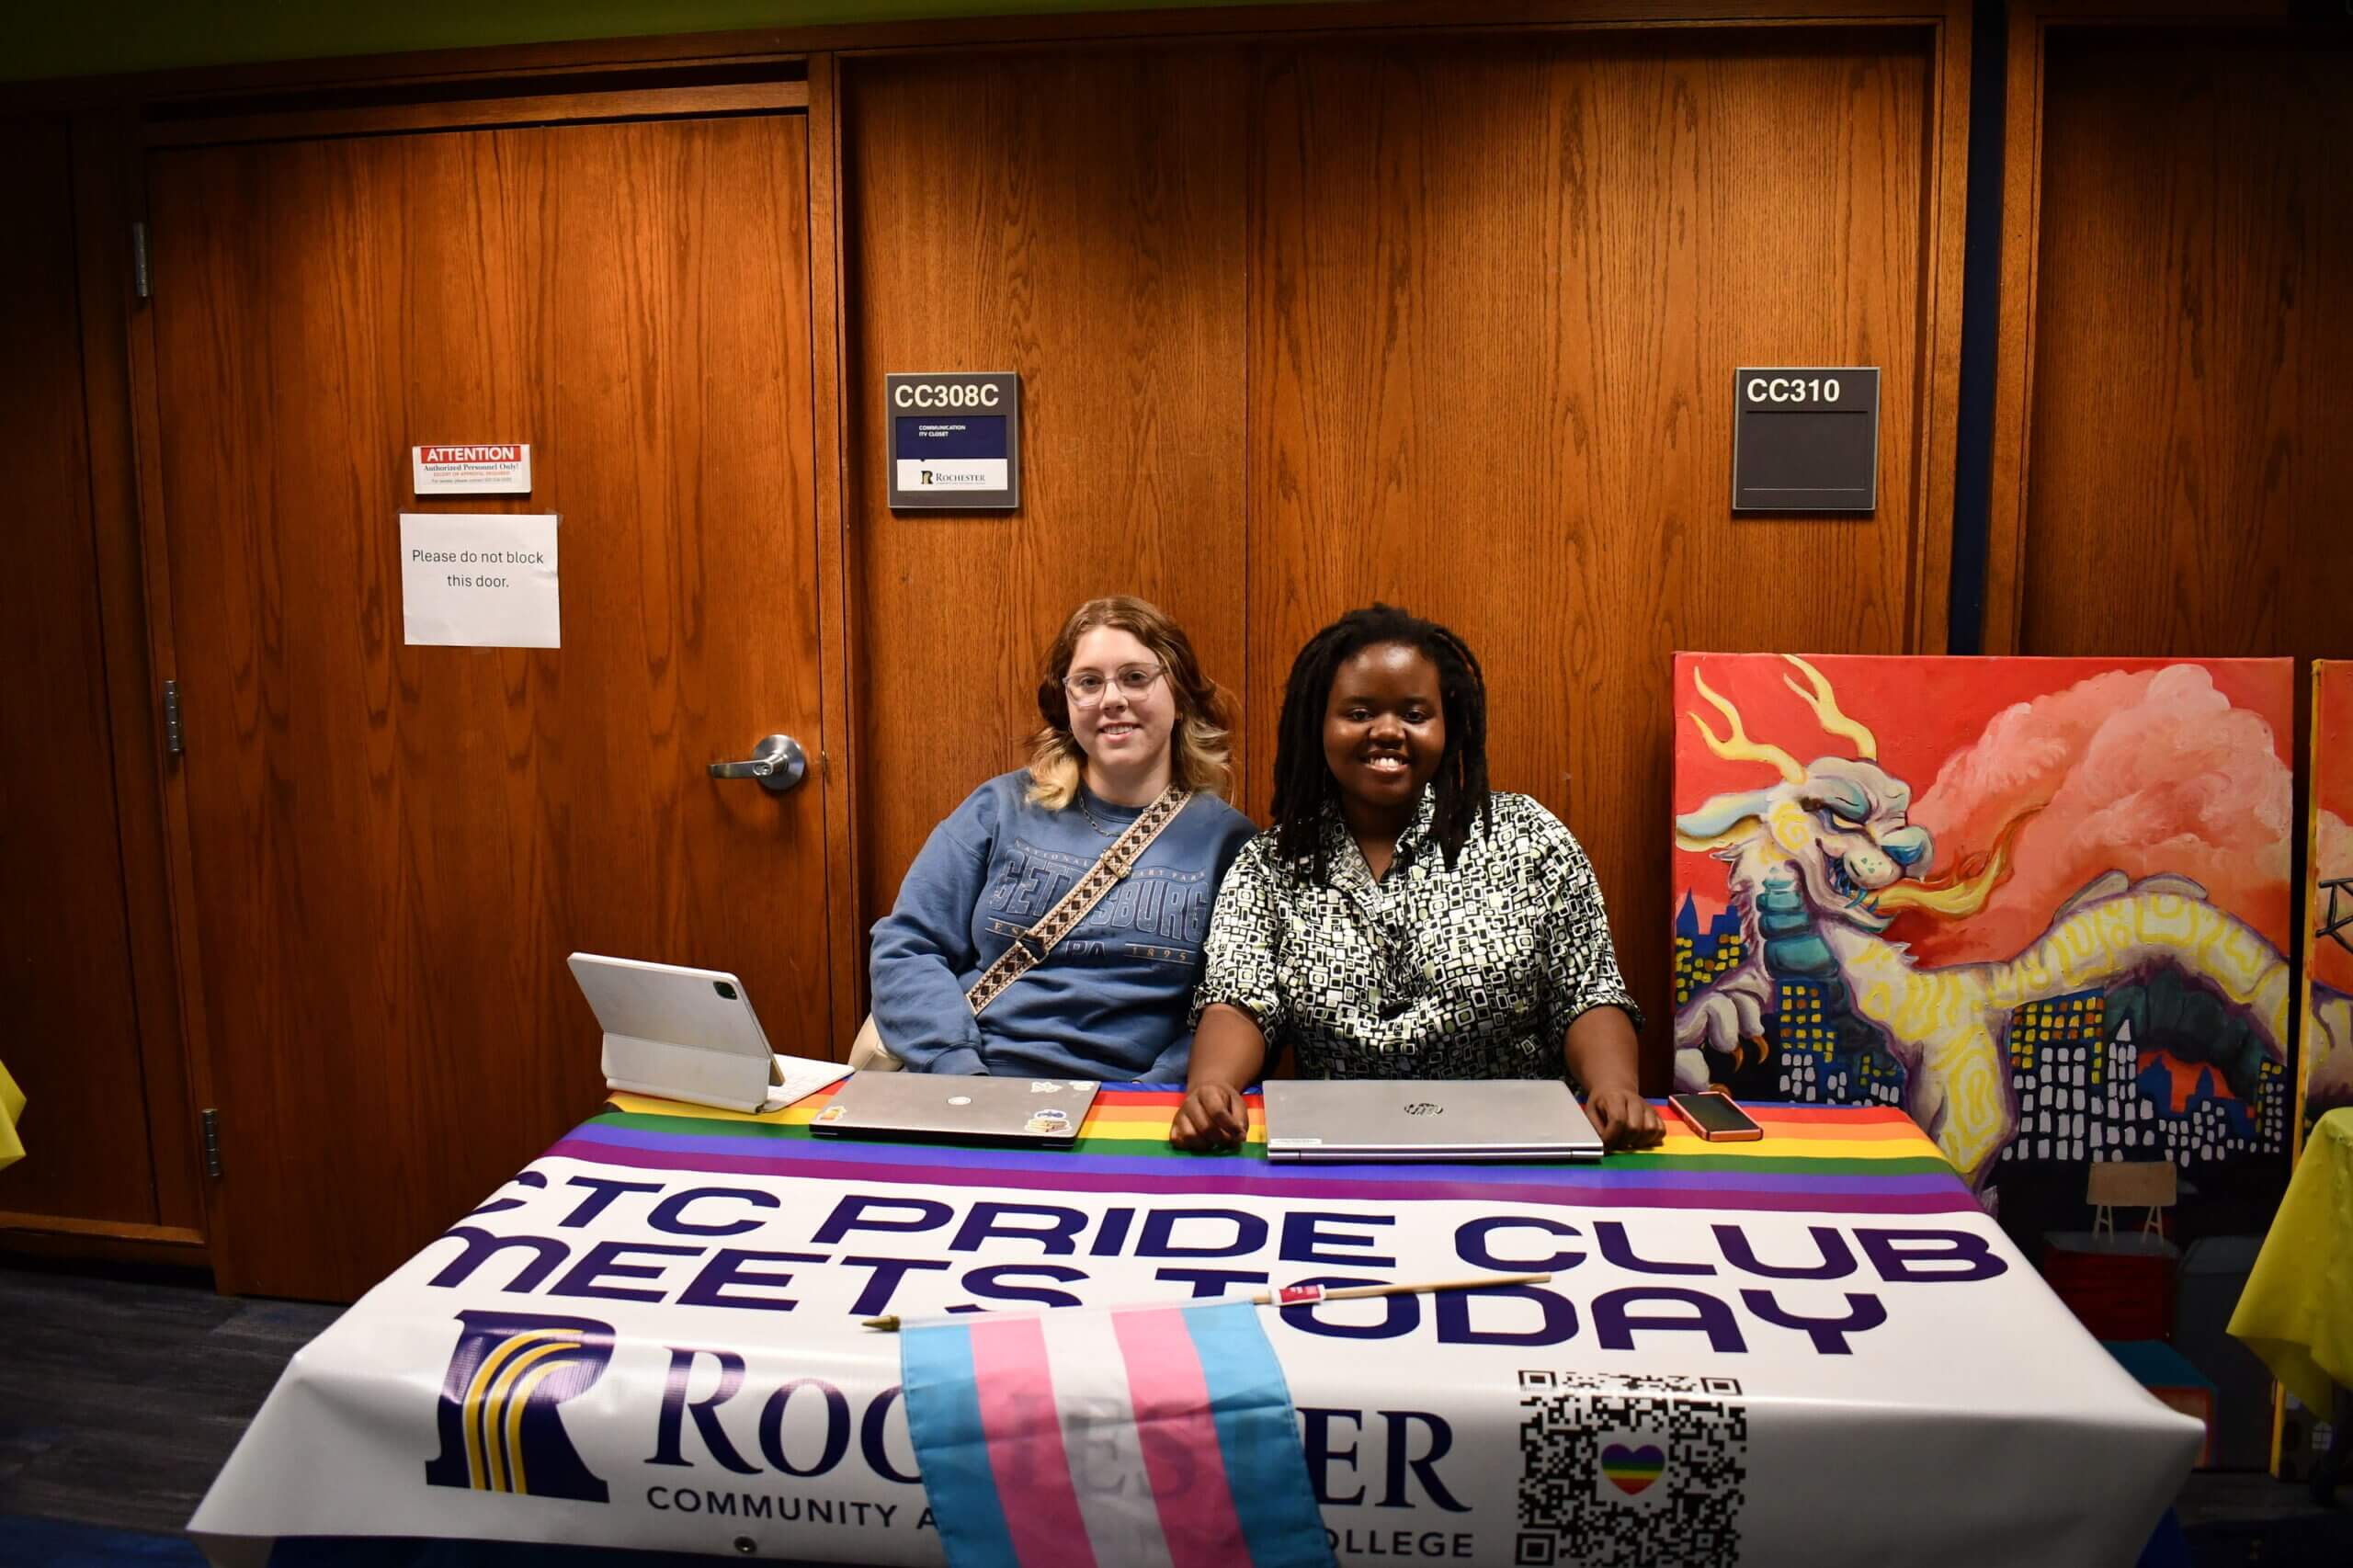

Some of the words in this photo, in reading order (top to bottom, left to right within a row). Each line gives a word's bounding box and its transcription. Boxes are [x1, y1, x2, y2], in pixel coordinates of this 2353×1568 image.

[894, 384, 999, 408] CC308C
[1746, 378, 1840, 403] CC310
[426, 447, 515, 462] ATTENTION
[424, 463, 461, 472] Authorized
[463, 462, 498, 471] Personnel
[936, 472, 985, 482] ROCHESTER
[413, 549, 457, 562] Please
[460, 551, 478, 562] do
[481, 551, 503, 563] not
[506, 551, 544, 563] block
[447, 574, 472, 587] this
[475, 574, 509, 588] door.
[990, 848, 1210, 943] GETSBURG
[1131, 947, 1188, 961] 1895
[810, 1194, 1397, 1267] PRIDE
[1454, 1215, 2009, 1283] CLUB
[426, 1225, 1091, 1316] MEETS
[1154, 1267, 1888, 1356] TODAY
[646, 1485, 898, 1528] COMMUNITY
[1324, 1528, 1473, 1558] LLEGE
